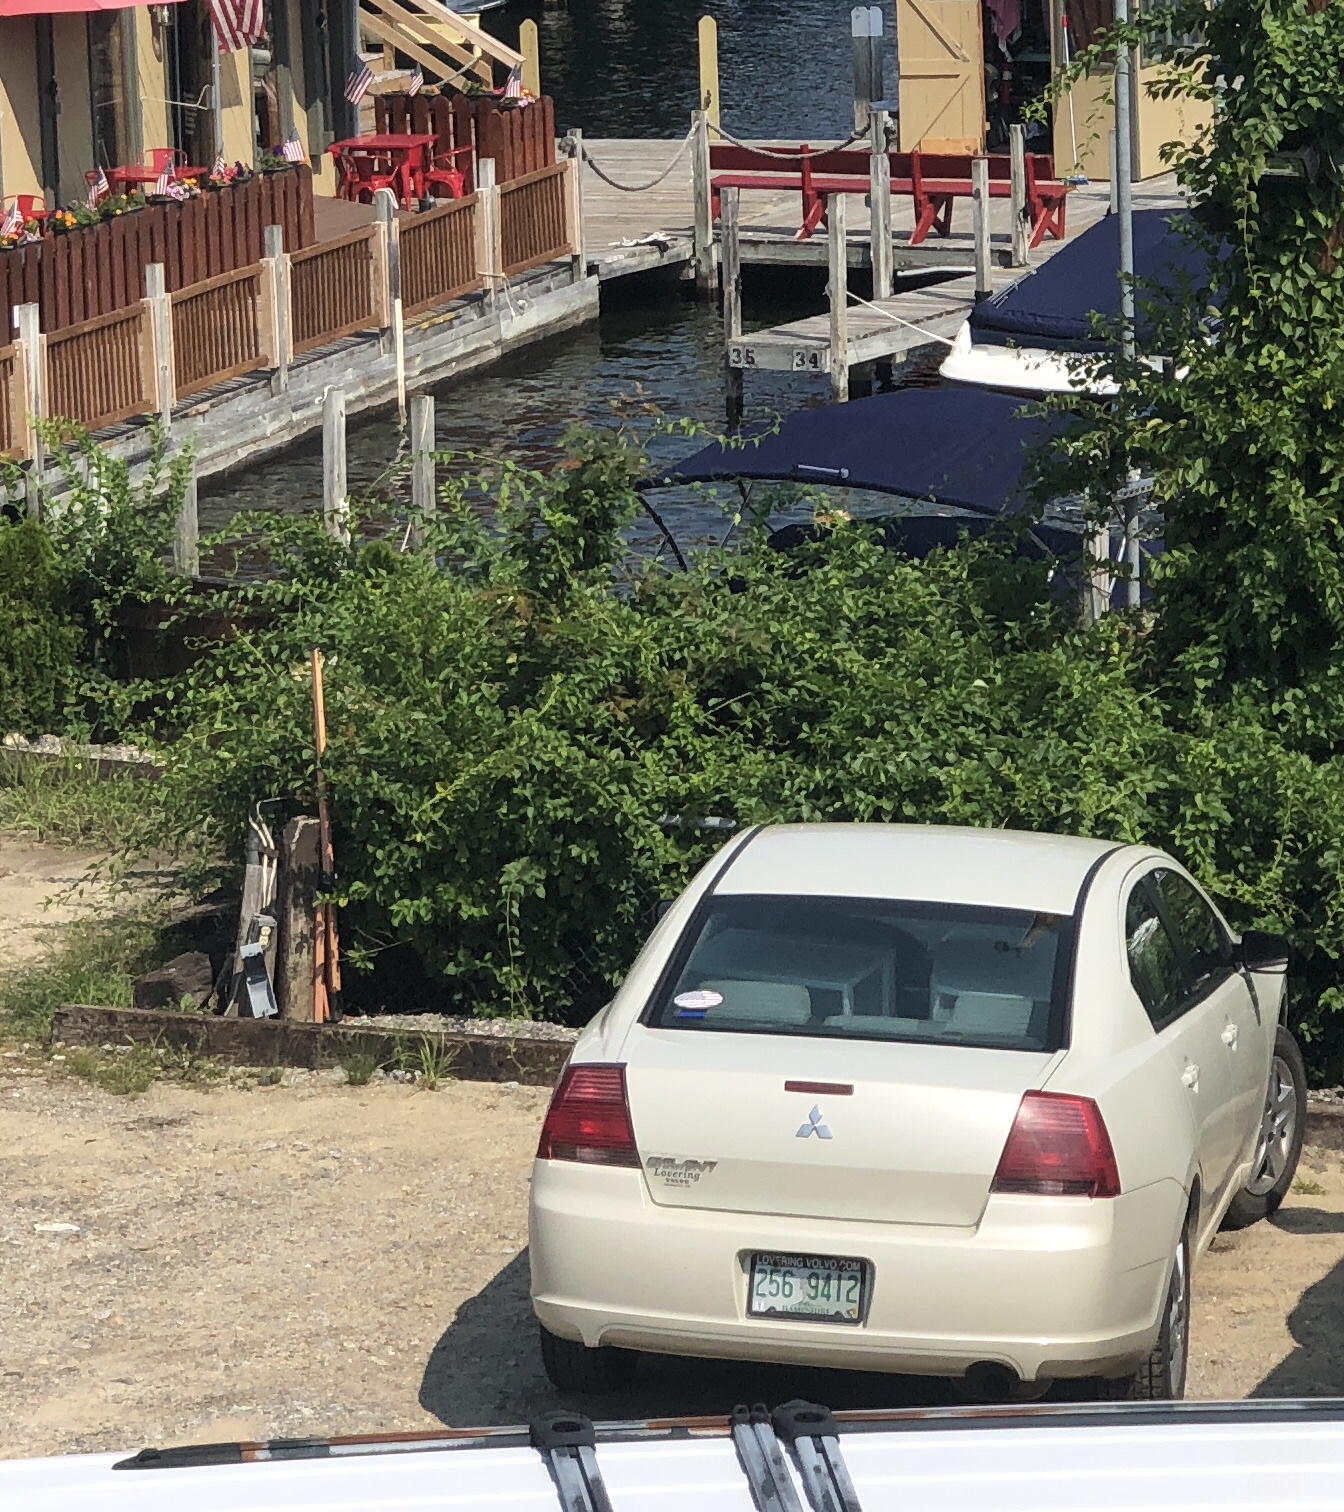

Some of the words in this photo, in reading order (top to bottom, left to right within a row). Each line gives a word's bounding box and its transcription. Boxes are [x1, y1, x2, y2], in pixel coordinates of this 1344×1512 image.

[731, 348, 756, 365] 35
[795, 349, 820, 369] 34
[654, 1167, 701, 1183] Lovering
[756, 1254, 804, 1268] LOVERING
[755, 1268, 794, 1299] 256
[806, 1271, 859, 1304] 9412
